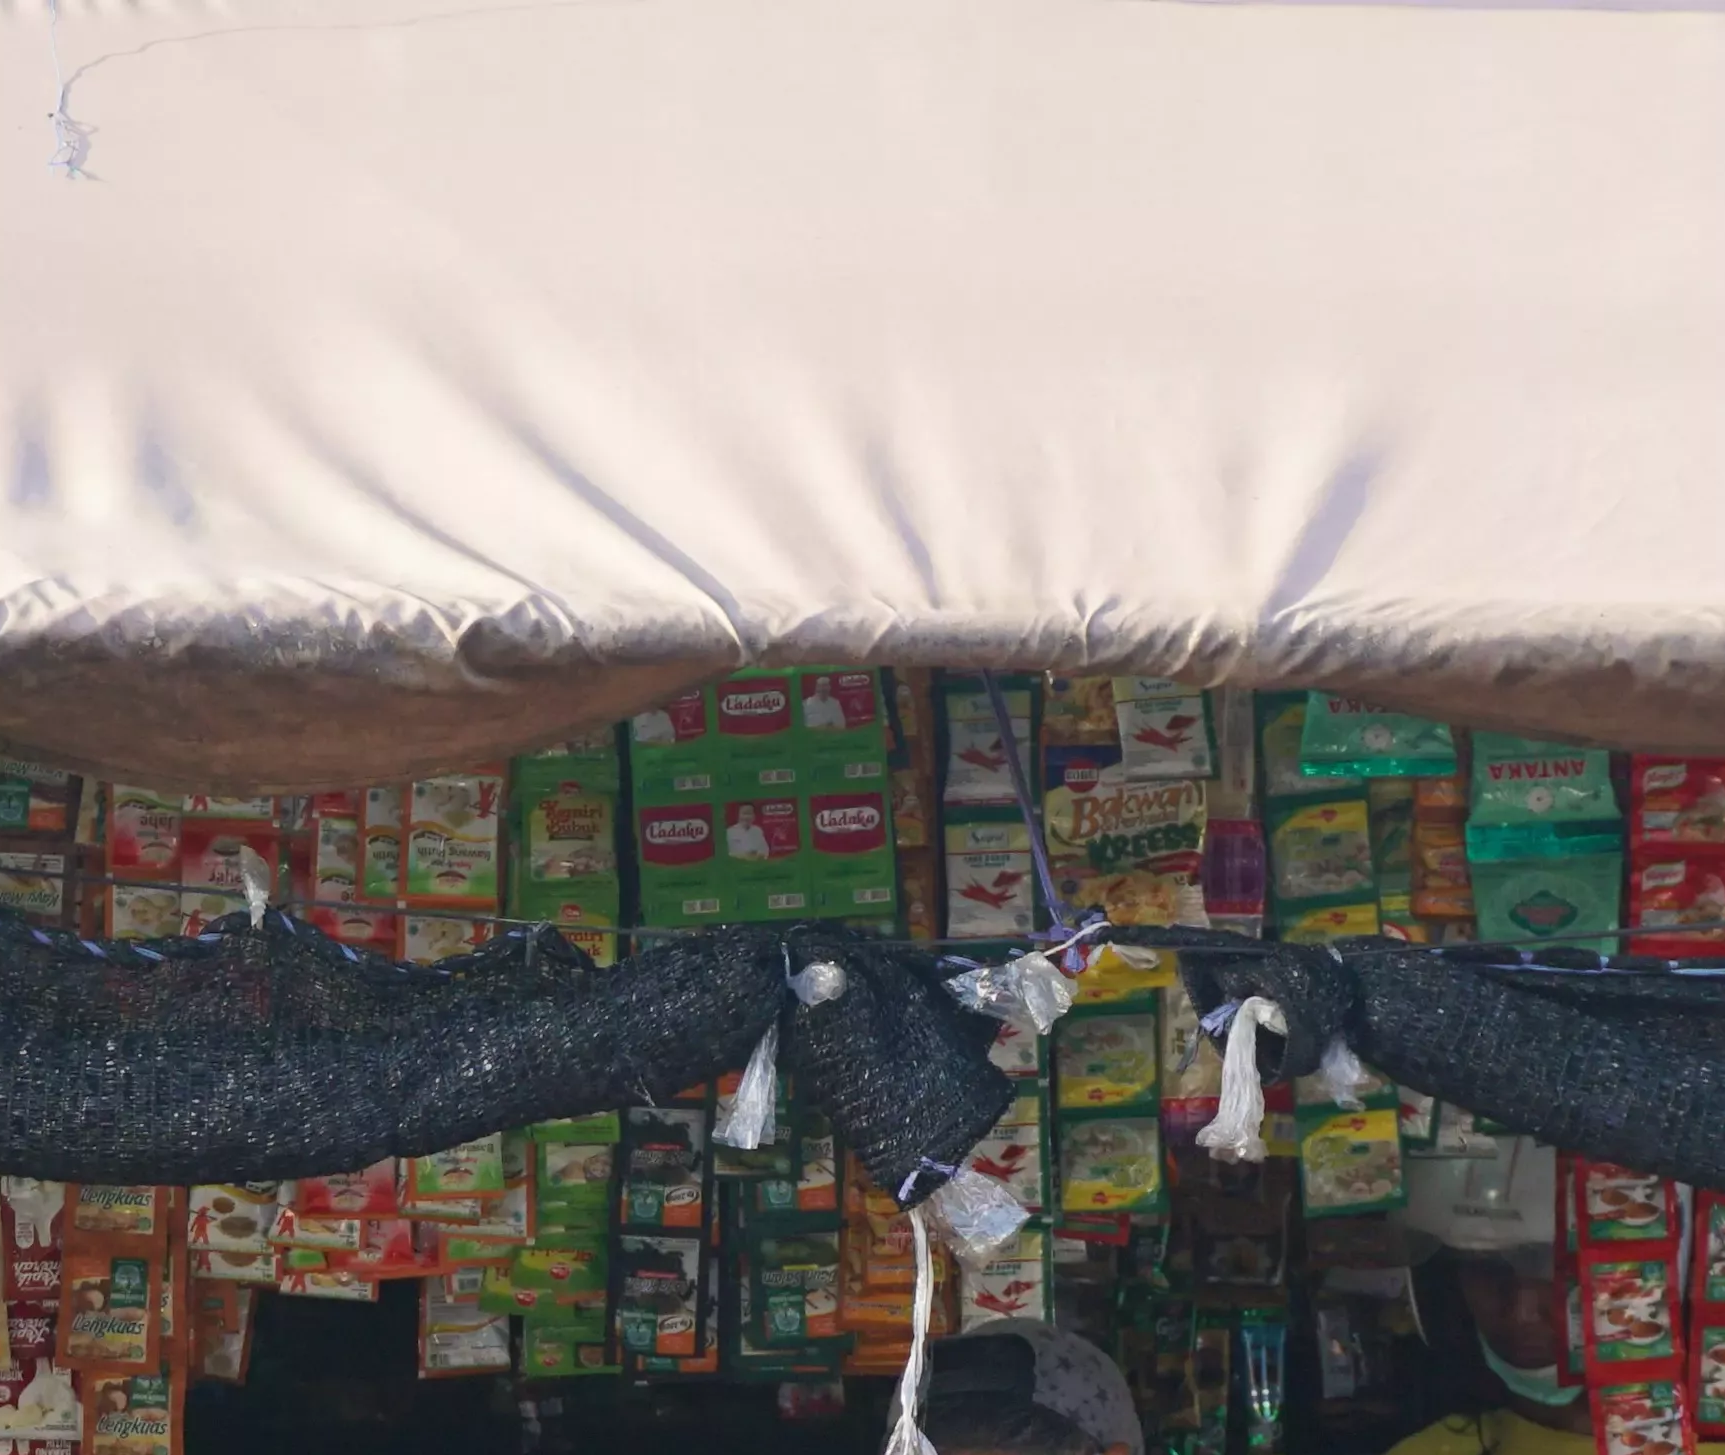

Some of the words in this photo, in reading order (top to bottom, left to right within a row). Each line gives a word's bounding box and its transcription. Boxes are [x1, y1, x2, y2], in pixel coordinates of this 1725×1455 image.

[725, 693, 780, 713] Ladaku
[1486, 758, 1587, 781] ANTAKA
[819, 807, 876, 829] Ladaku
[1070, 781, 1193, 842] Bakwan
[649, 821, 705, 842] Ladaku
[80, 1186, 153, 1210] Lengkuas
[761, 1270, 802, 1288] Salam
[6, 1315, 53, 1332] mera
[72, 1312, 145, 1338] Lengkuas
[8, 1325, 51, 1345] Kepi
[96, 1414, 168, 1438] Lengkuas
